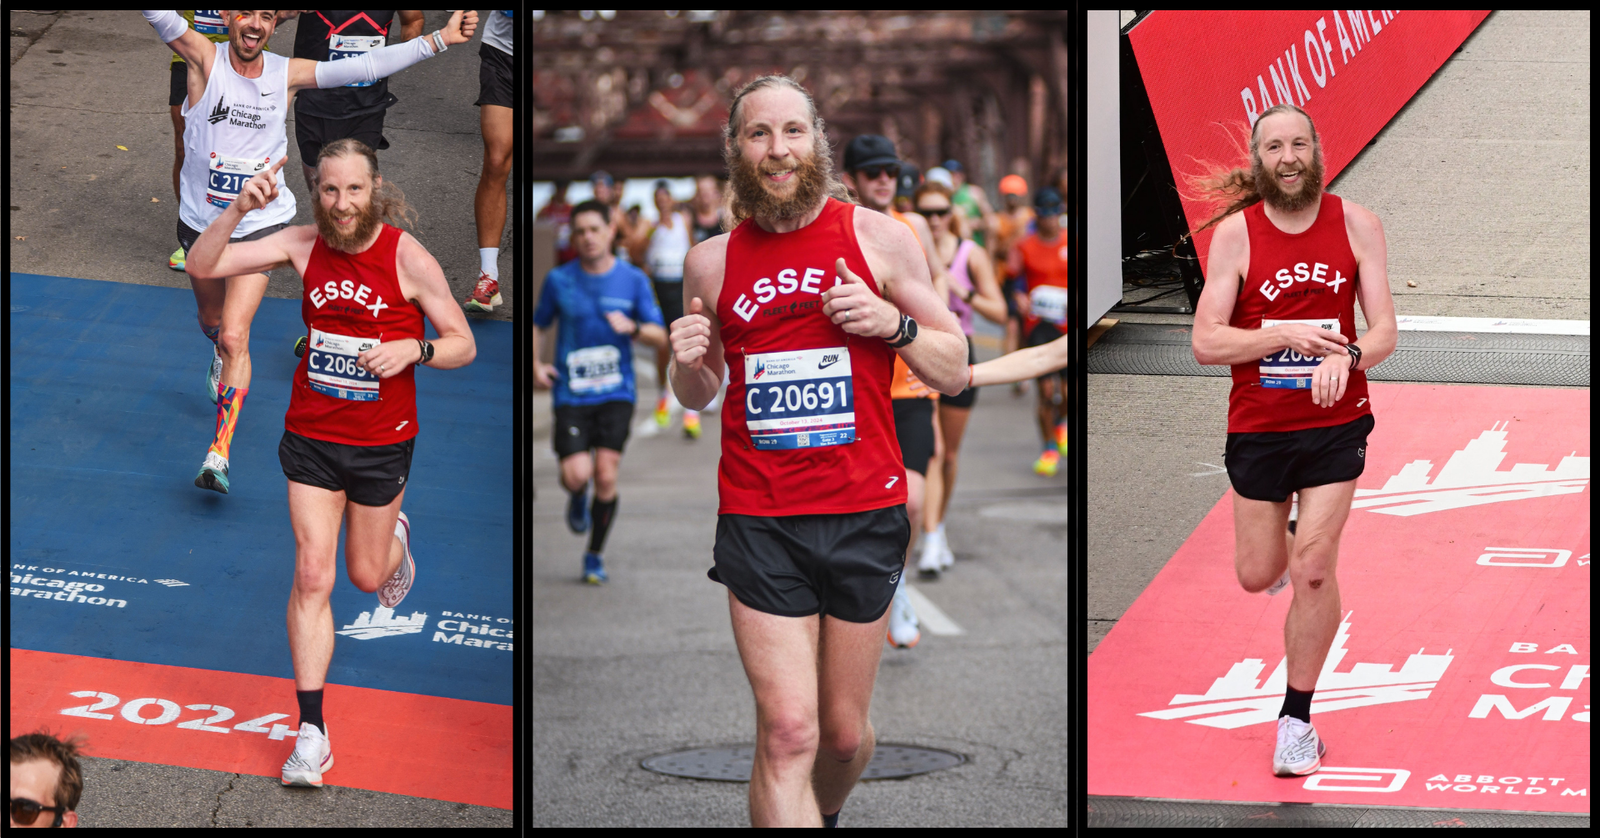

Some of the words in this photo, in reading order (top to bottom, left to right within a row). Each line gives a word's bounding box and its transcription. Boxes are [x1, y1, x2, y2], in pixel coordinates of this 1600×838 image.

[1241, 44, 1311, 129] BANK
[1304, 17, 1336, 88] OF
[231, 109, 261, 122] Chicago
[229, 117, 266, 130] Marathon
[210, 172, 219, 187] C
[1259, 262, 1347, 302] ESSEX
[309, 279, 389, 318] ESSEX
[732, 267, 842, 323] ESSE
[763, 305, 788, 317] FLEET
[799, 300, 820, 309] FEET
[309, 351, 320, 370] C
[822, 354, 839, 363] RUN
[766, 363, 790, 371] Chicago
[747, 388, 762, 415] C
[768, 381, 847, 413] 20691
[68, 570, 148, 584] AMERICA
[442, 611, 492, 621] BANK
[496, 617, 513, 625] O
[60, 690, 298, 741] 2024
[1427, 774, 1565, 786] ABBOTT
[1425, 783, 1547, 795] WORLD
